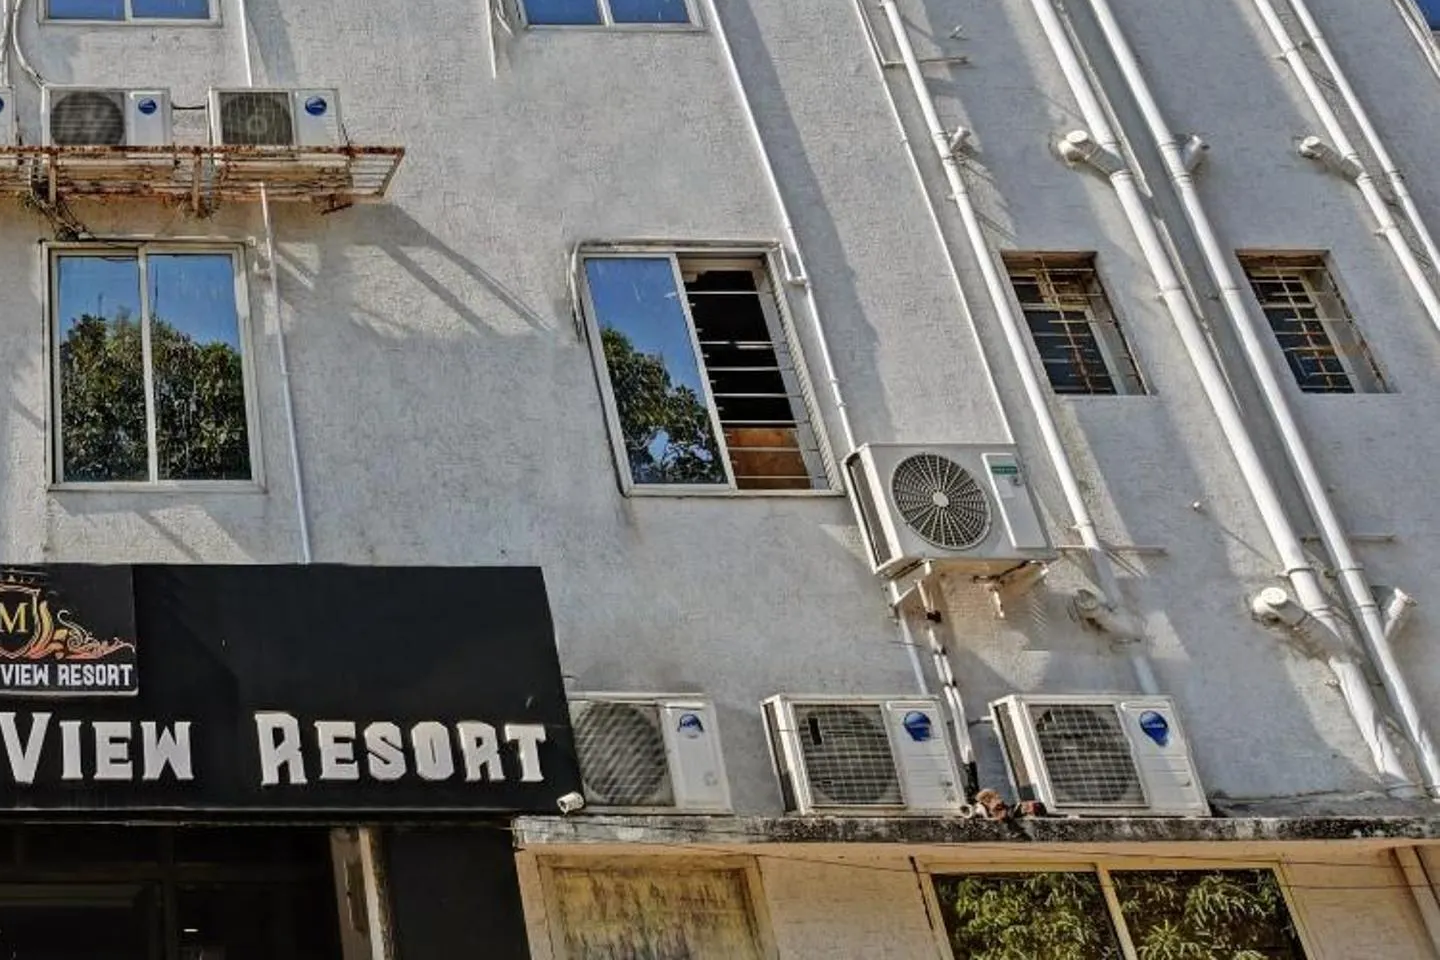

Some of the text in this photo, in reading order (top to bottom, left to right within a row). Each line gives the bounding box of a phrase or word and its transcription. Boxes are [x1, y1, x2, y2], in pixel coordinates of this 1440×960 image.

[0, 663, 49, 686] VIEW
[58, 663, 133, 686] RESORT
[254, 711, 545, 786] RESORT
